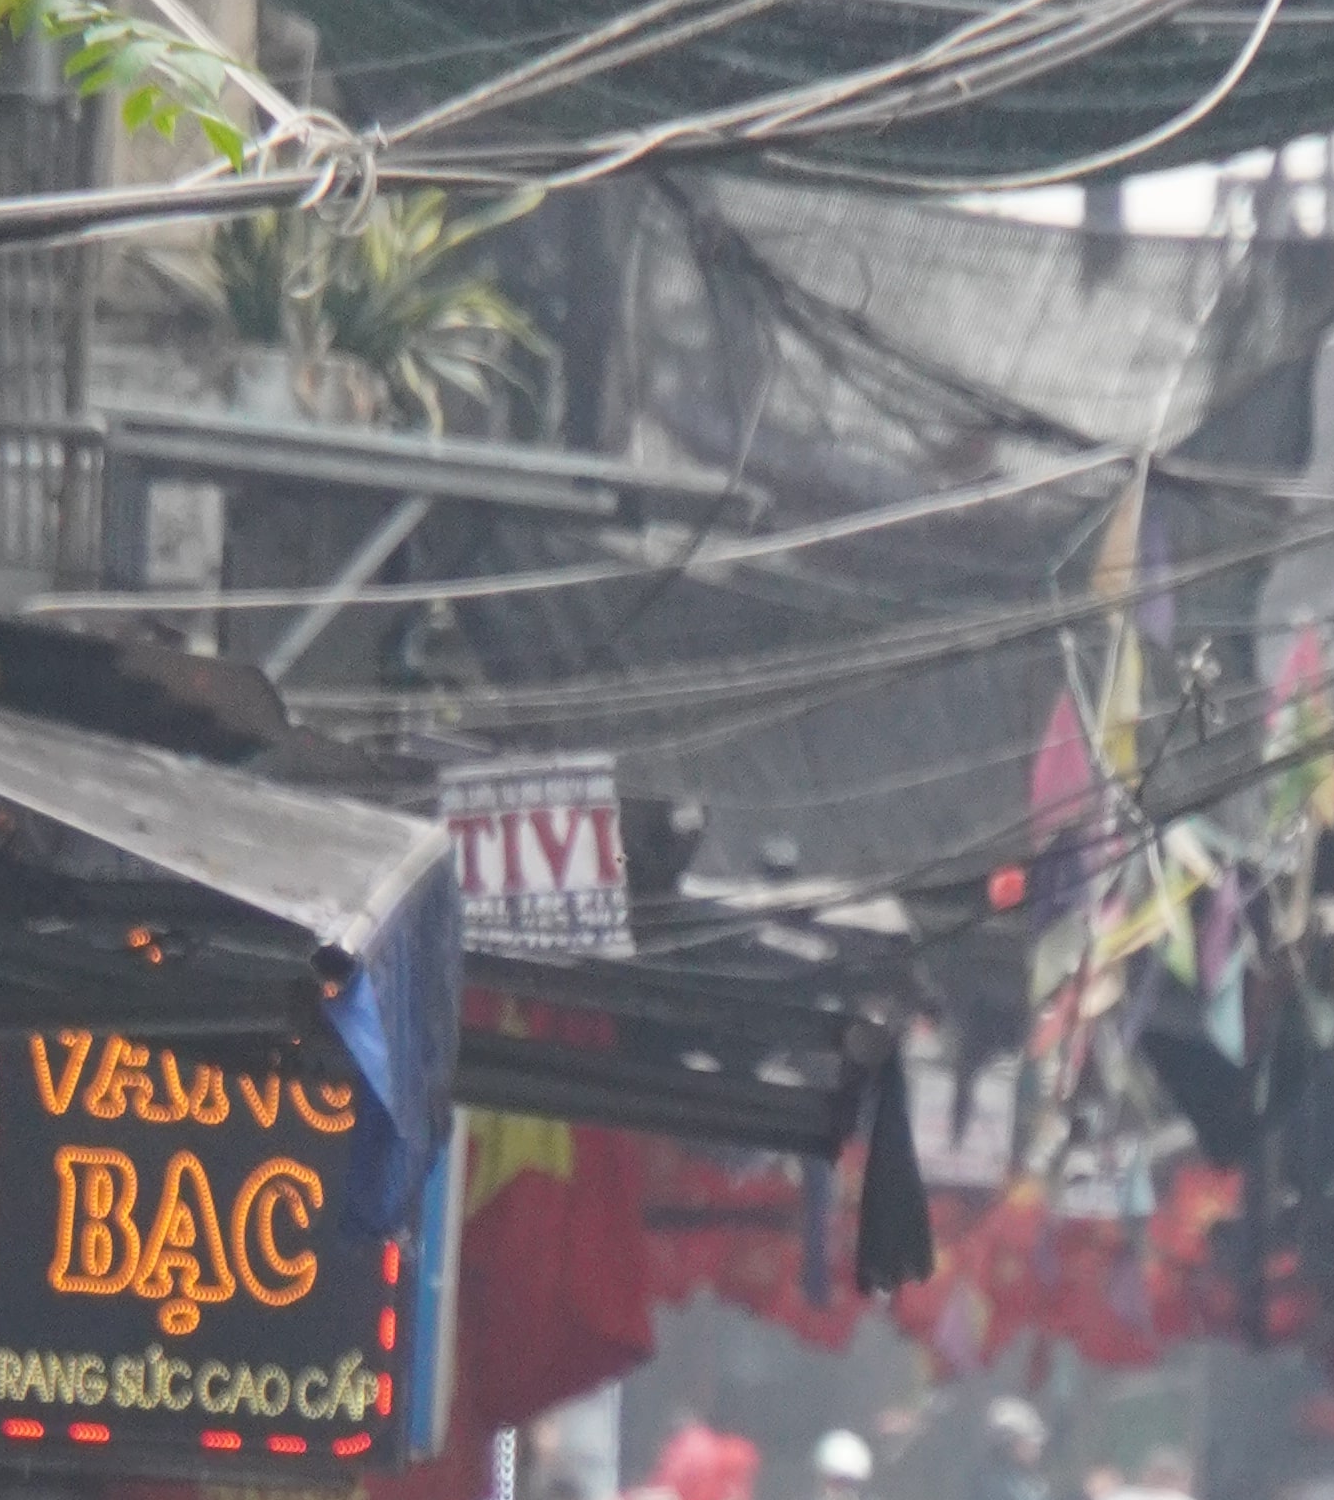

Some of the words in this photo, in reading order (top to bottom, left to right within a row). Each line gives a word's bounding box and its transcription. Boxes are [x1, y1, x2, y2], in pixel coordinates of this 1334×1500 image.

[446, 804, 621, 897] TIVI
[47, 1145, 323, 1336] BẠC
[110, 1341, 194, 1411] SÚC
[195, 1359, 292, 1417] CAO
[295, 1347, 380, 1423] CẤP
